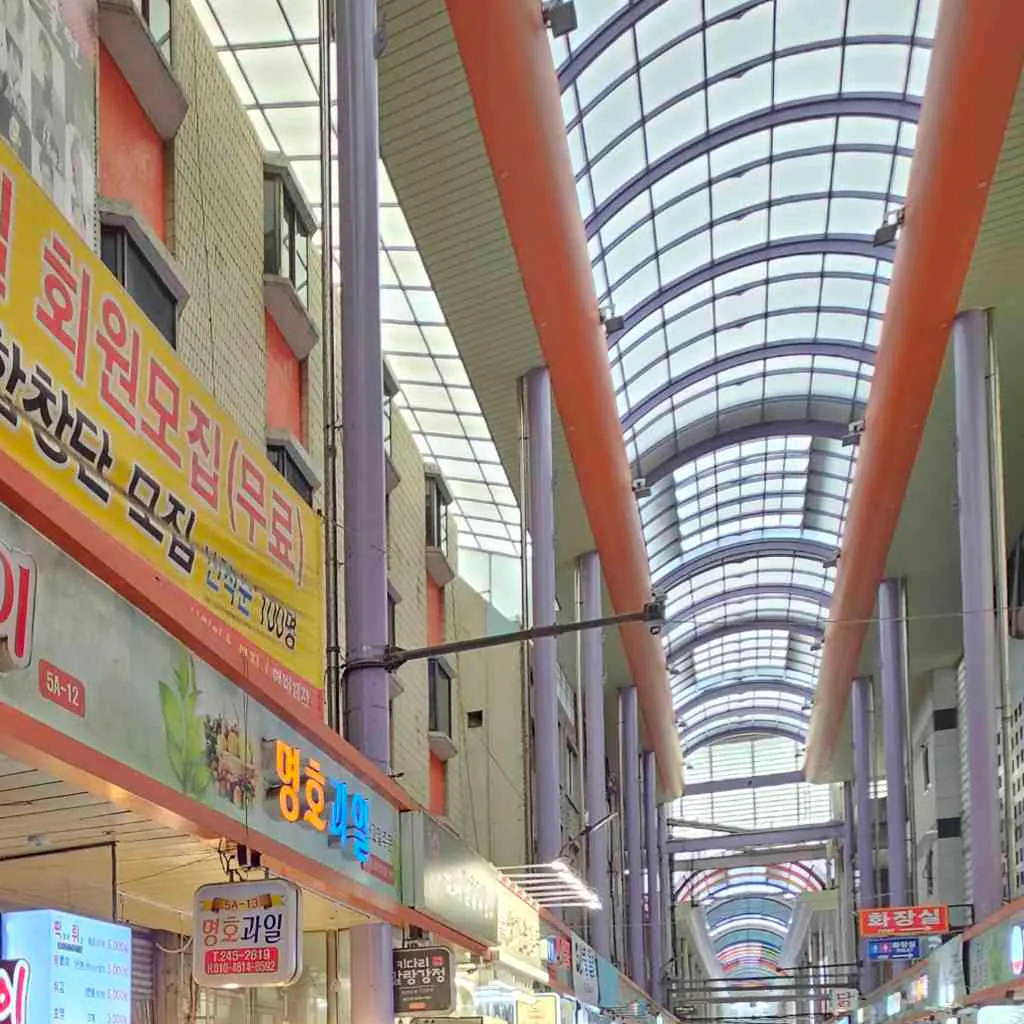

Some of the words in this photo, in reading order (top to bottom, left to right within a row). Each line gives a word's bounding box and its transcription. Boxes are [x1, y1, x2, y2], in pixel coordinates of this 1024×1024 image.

[36, 232, 304, 585] 회원모집(무료)
[128, 463, 196, 574] 모집
[47, 671, 79, 706] 5A-12
[276, 739, 369, 863] 명호과일
[224, 899, 258, 911] 5A-13
[867, 909, 941, 928] 화장실
[202, 913, 282, 947] 명호과일
